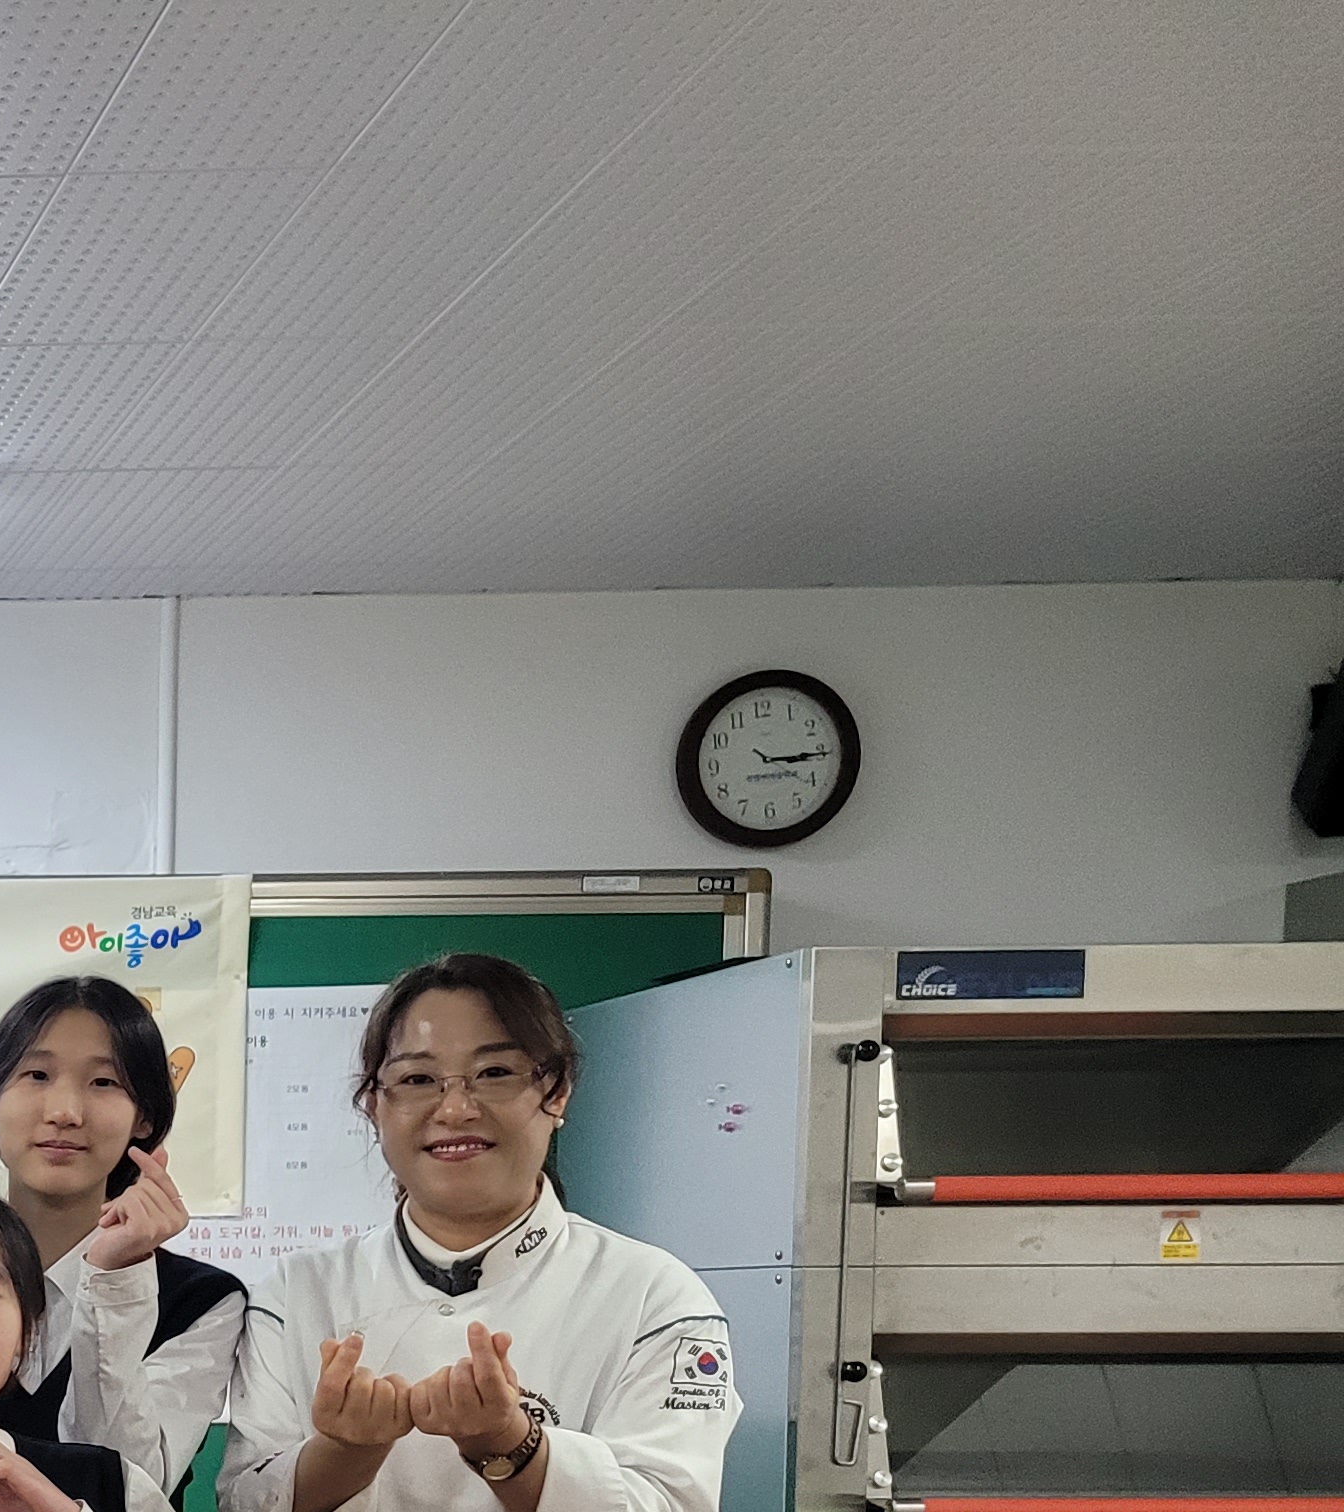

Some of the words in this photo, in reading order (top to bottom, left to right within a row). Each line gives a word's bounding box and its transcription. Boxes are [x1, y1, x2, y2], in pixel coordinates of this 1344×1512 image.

[754, 701, 771, 719] 12
[787, 703, 795, 721] 1
[730, 711, 744, 730] 11
[804, 719, 816, 737] 2
[713, 731, 729, 750] 10
[708, 759, 720, 777] 9
[803, 771, 817, 787] 4
[717, 783, 730, 800] 8
[792, 792, 802, 809] 5
[737, 799, 749, 817] 7
[764, 802, 776, 819] 6
[131, 905, 178, 920] 경남교육
[59, 918, 202, 968] 아이좋아
[901, 984, 957, 996] CHOICE
